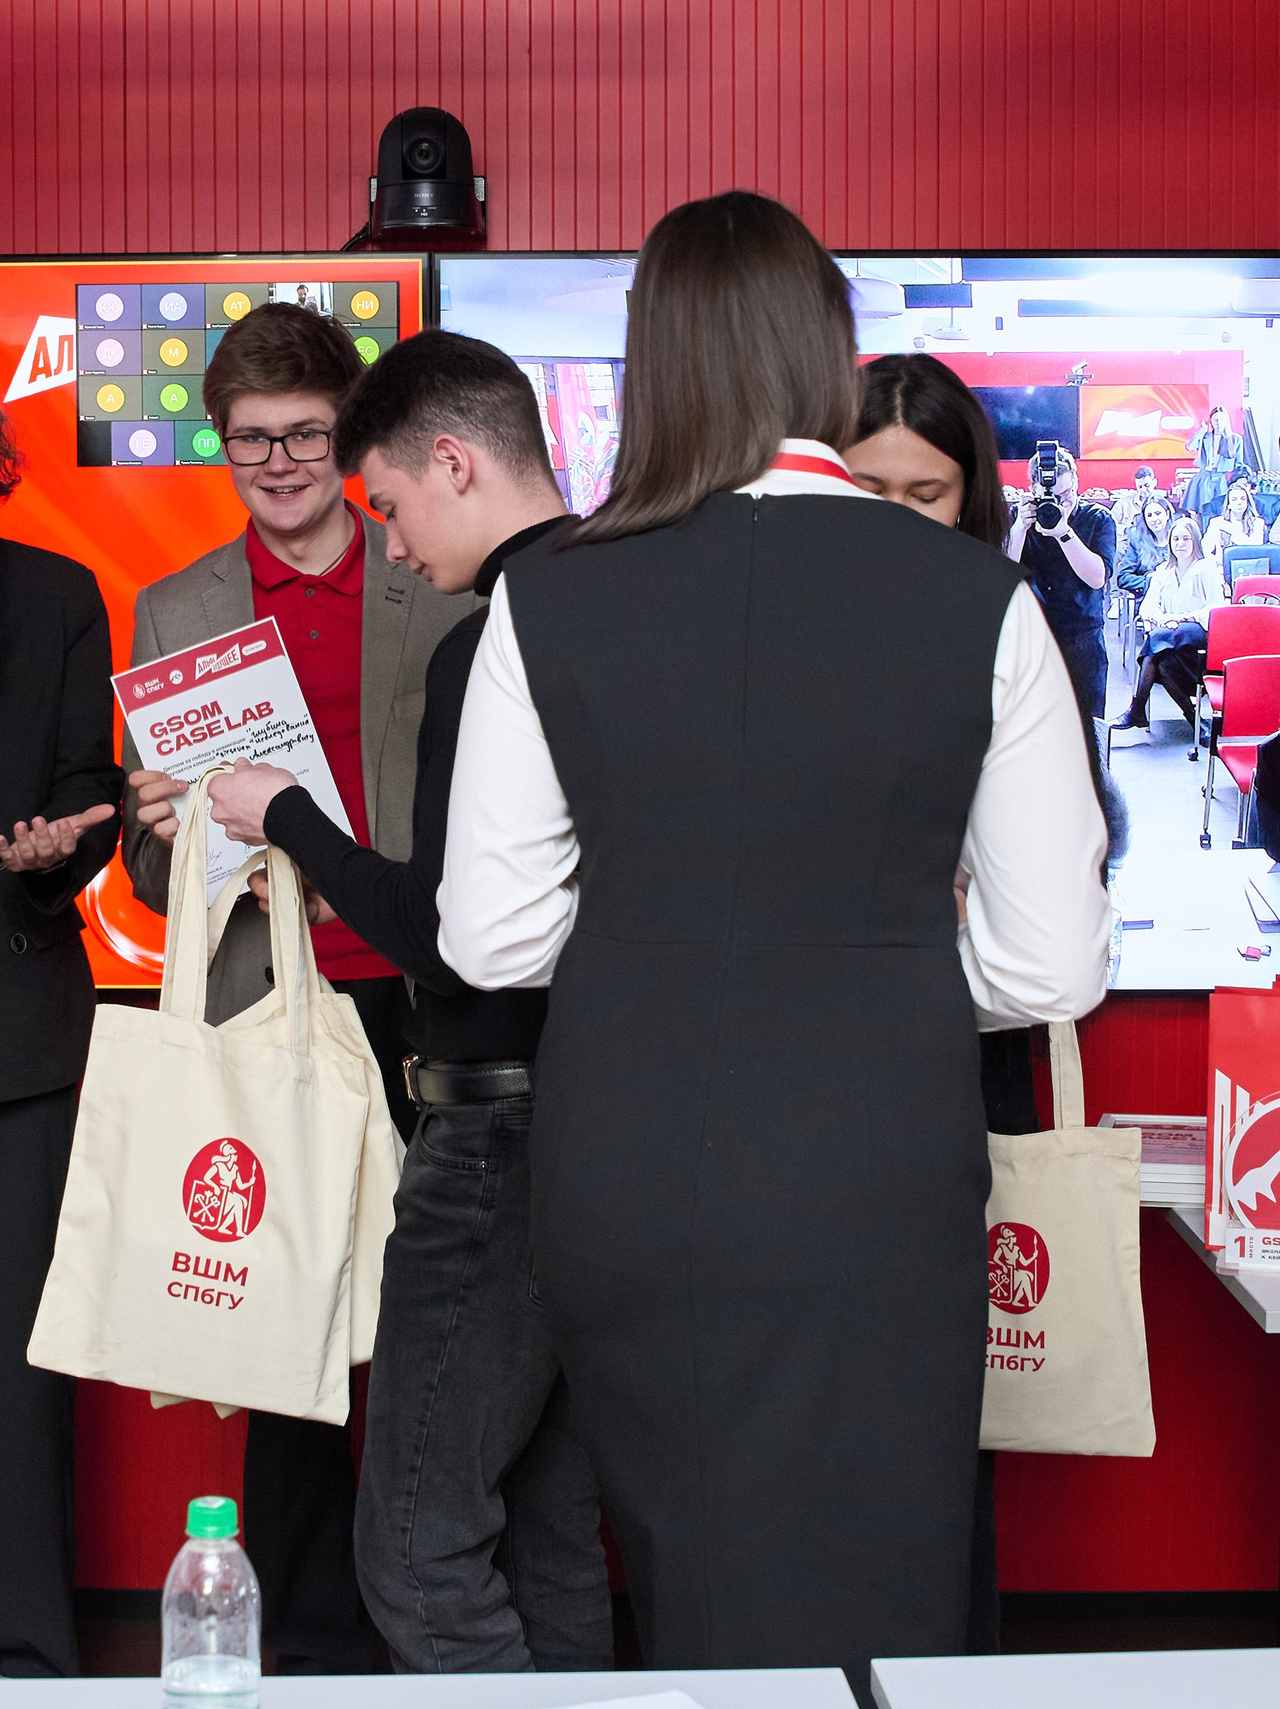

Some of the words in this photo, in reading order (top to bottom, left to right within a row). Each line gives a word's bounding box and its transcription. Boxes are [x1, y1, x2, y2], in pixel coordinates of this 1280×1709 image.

[165, 302, 182, 312] ИА
[229, 301, 245, 311] АТ
[356, 300, 374, 310] НИ
[198, 438, 215, 448] ПП
[149, 700, 224, 740] GSOM
[156, 719, 225, 757] CASE
[223, 701, 274, 732] LAB
[1233, 1235, 1246, 1258] 1
[1262, 1236, 1280, 1246] GS
[171, 1250, 249, 1287] ВШМ
[167, 1281, 245, 1311] СПбГУ
[986, 1353, 1046, 1372] ПбГУ
